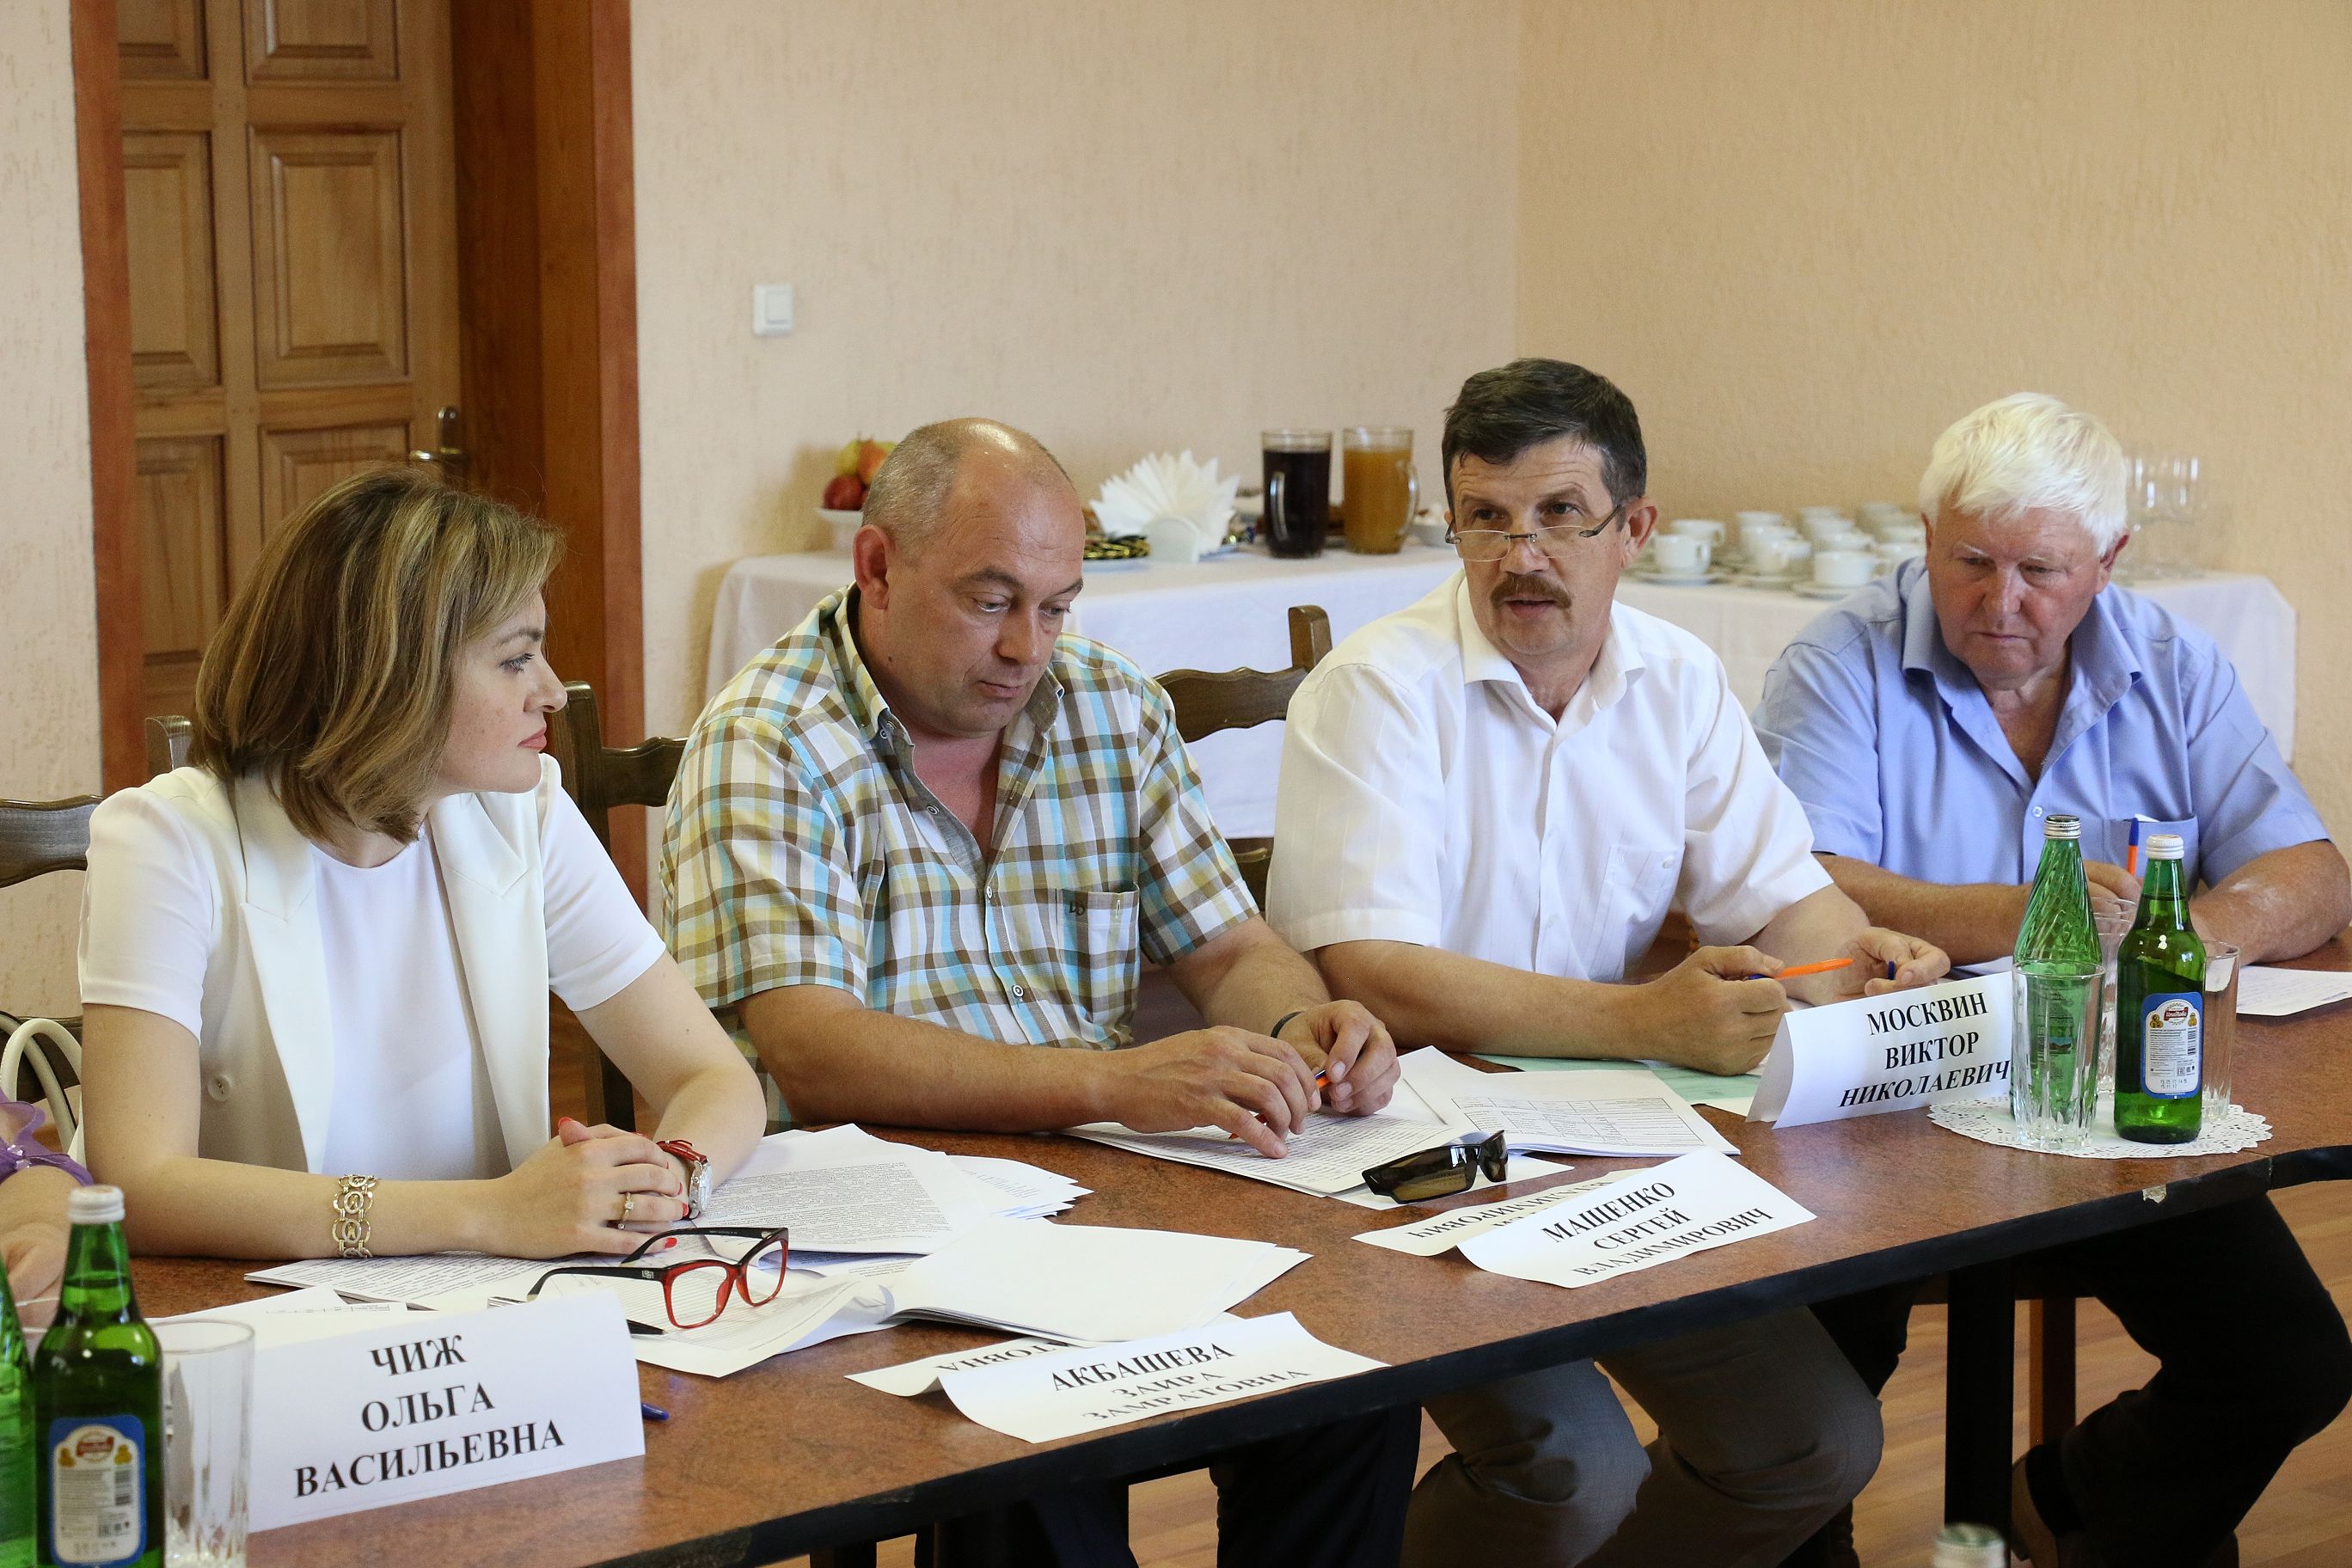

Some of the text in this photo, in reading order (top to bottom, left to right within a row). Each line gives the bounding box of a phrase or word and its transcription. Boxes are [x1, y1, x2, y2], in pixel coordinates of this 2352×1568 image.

[1866, 992, 1988, 1036] МОСКВИН
[1884, 1032, 1980, 1070] ВИКТОР
[1838, 1059, 2011, 1108] НИКОЛАЕВИЧ
[1540, 1182, 1675, 1243] МАЩЕНКО
[1593, 1207, 1693, 1250] СЕРГЕЙ
[1571, 1208, 1775, 1275] ВЛАДИМИРОВИЧ
[369, 1334, 469, 1376] ЧИЖ
[1051, 1343, 1238, 1392] АКБАШЕВА
[361, 1381, 496, 1432] ОЛЬГА
[1081, 1369, 1313, 1420] ЗАМРАТОВНА
[1112, 1371, 1226, 1398] ЗАИРА
[293, 1419, 566, 1498] ВАСИЛЬЕВНА
